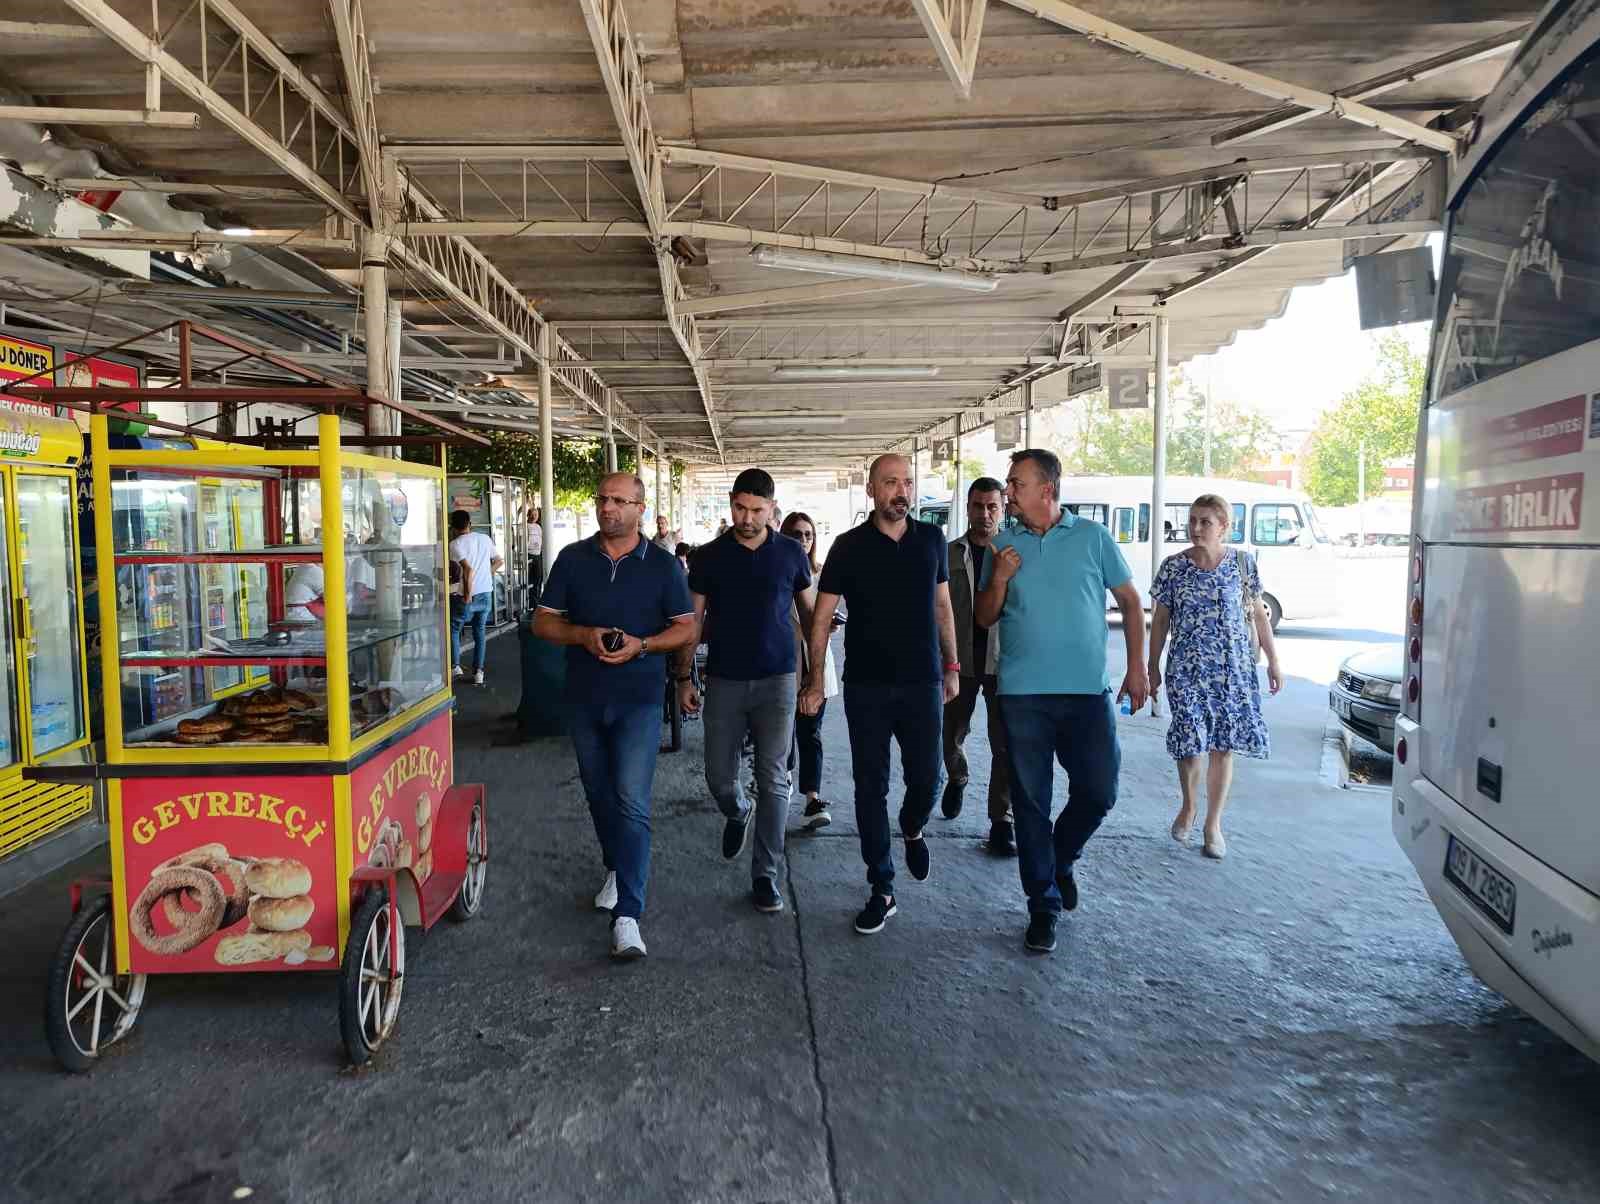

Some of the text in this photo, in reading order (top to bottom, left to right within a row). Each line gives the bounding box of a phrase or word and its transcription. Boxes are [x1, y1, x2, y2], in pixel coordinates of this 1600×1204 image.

[9, 346, 48, 371] DÖNER
[1119, 374, 1139, 403] 2
[936, 442, 949, 459] 4
[1502, 479, 1577, 528] BİRLİK
[131, 790, 327, 848] GEVREKÇİ
[356, 745, 448, 855] GEVREKÇİ
